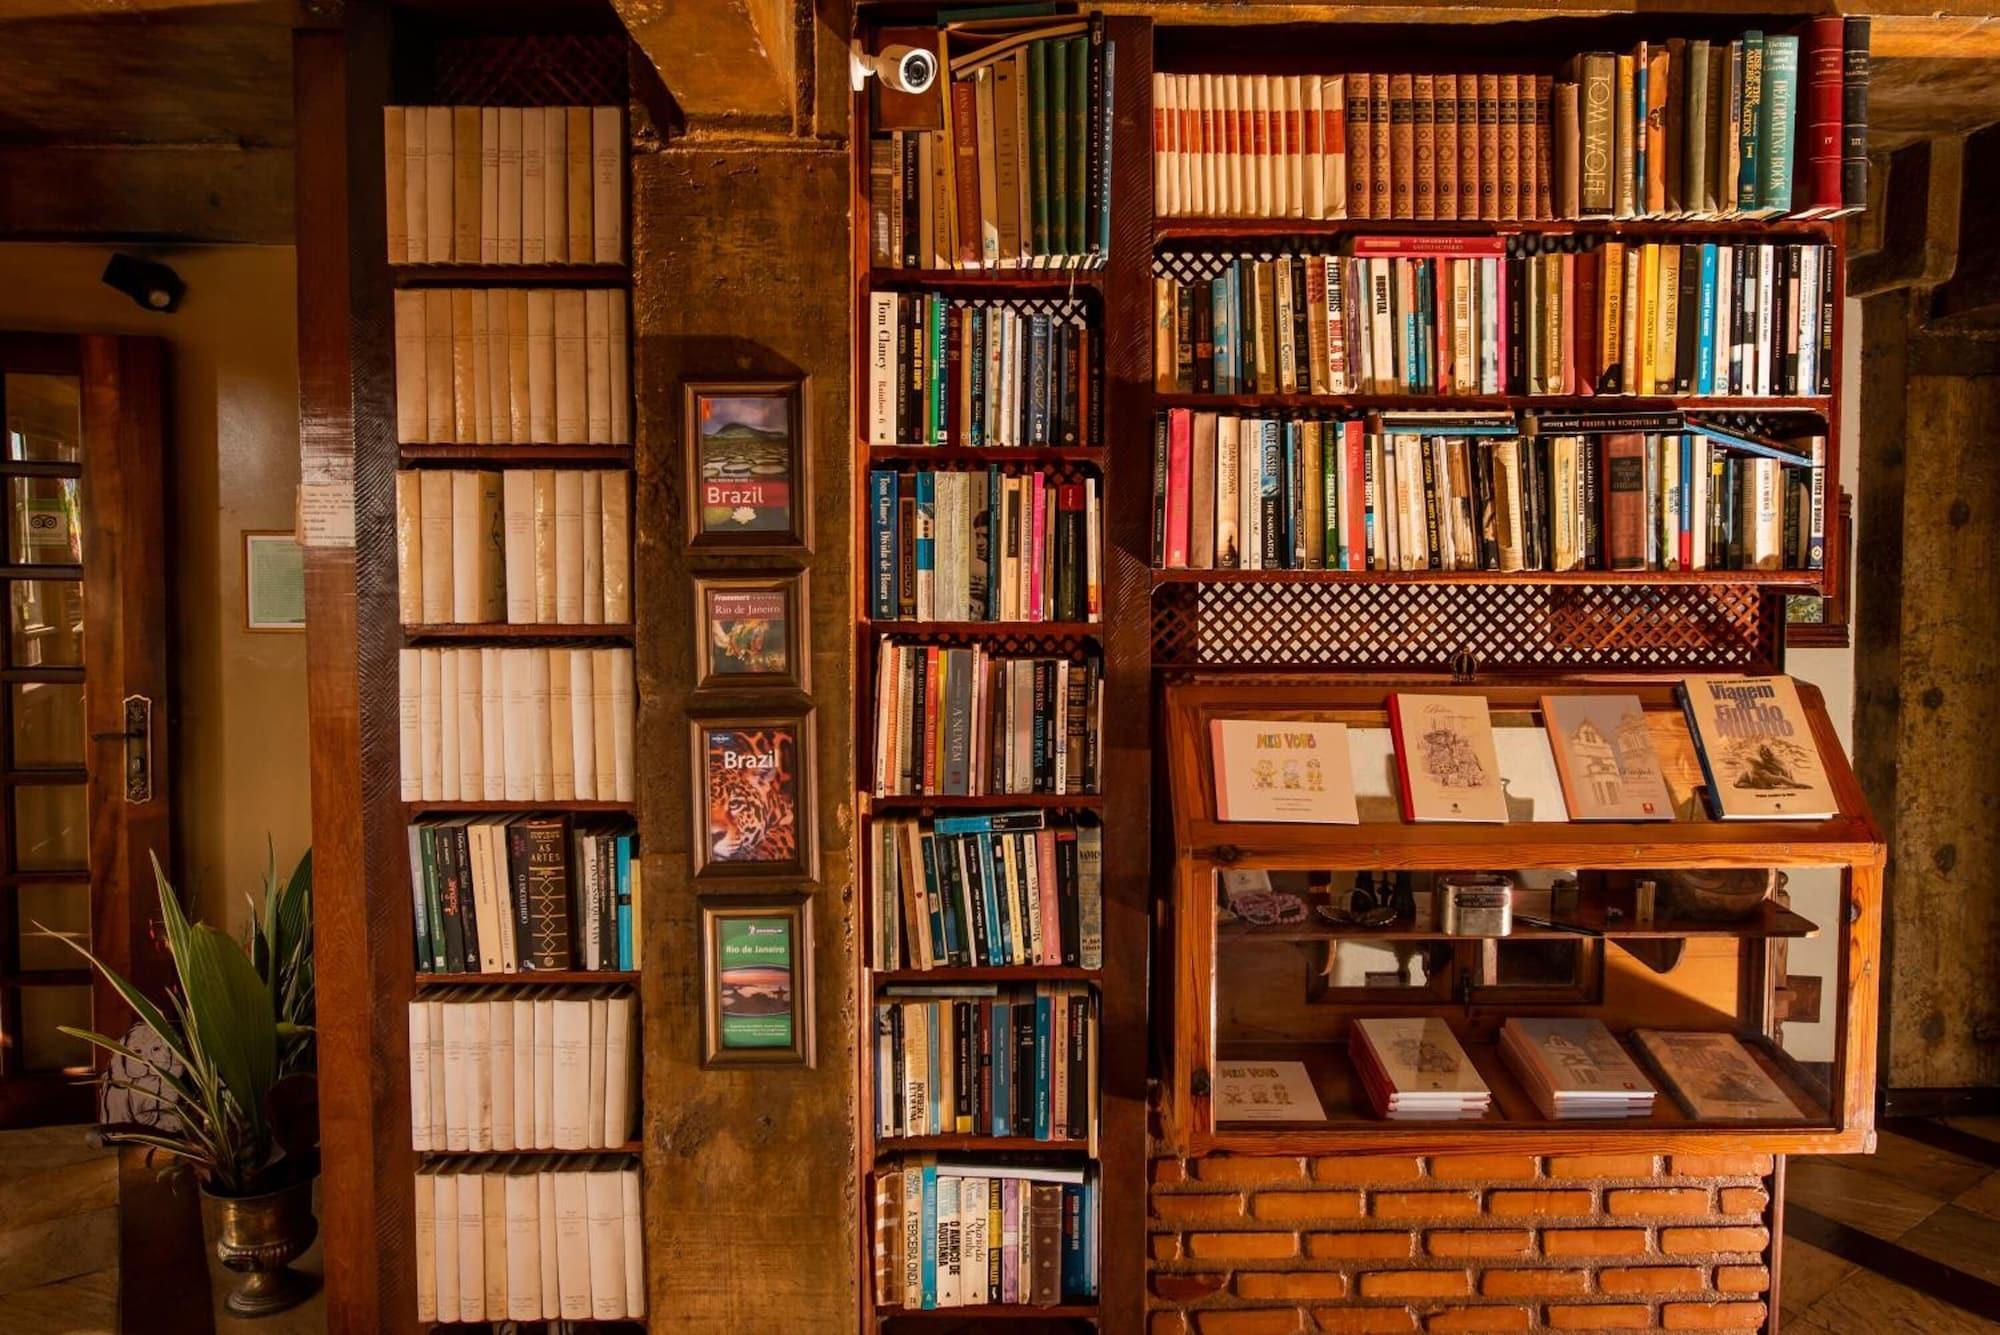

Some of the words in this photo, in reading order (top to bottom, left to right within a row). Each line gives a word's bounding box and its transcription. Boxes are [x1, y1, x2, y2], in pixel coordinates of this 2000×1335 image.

[1744, 49, 1754, 98] AMERICAN
[1587, 74, 1610, 124] TOM
[1743, 101, 1753, 137] NATION
[1770, 80, 1789, 154] DECORATING
[1584, 132, 1608, 196] WOLFE
[1769, 157, 1787, 190] BOOK
[1327, 262, 1341, 286] LEON
[1666, 266, 1677, 301] JAVIER
[1328, 288, 1342, 312] URIS
[1376, 275, 1387, 315] HOSPITAL
[878, 299, 891, 326] Tom
[939, 303, 947, 332] ISABEL
[1665, 303, 1676, 337] SIERRA
[875, 330, 891, 370] Clancy
[1329, 319, 1344, 354] MILA
[878, 380, 889, 415] Rainbow
[1228, 443, 1236, 462] DAN
[880, 476, 891, 495] Tom
[1228, 463, 1237, 495] BROWN
[707, 486, 765, 504] Brazil
[877, 498, 891, 526] Clancy
[880, 560, 891, 571] de
[880, 573, 891, 600] Honra
[715, 604, 732, 615] Rio
[734, 604, 746, 615] de
[748, 604, 781, 616] Janeiro
[1709, 685, 1775, 701] Viagem
[953, 707, 962, 716] A
[952, 718, 963, 761] NUVEM
[724, 750, 778, 769] Brazil
[531, 853, 561, 864] ARTES
[726, 945, 740, 954] Rio
[741, 945, 753, 954] de
[754, 945, 785, 954] Janeiro
[908, 1081, 917, 1121] LUDLUM
[916, 1082, 925, 1119] ROBERT
[907, 1219, 918, 1261] TERCEIRA
[949, 1265, 960, 1275] DE
[975, 1249, 986, 1263] da
[907, 1262, 918, 1287] ONDA
